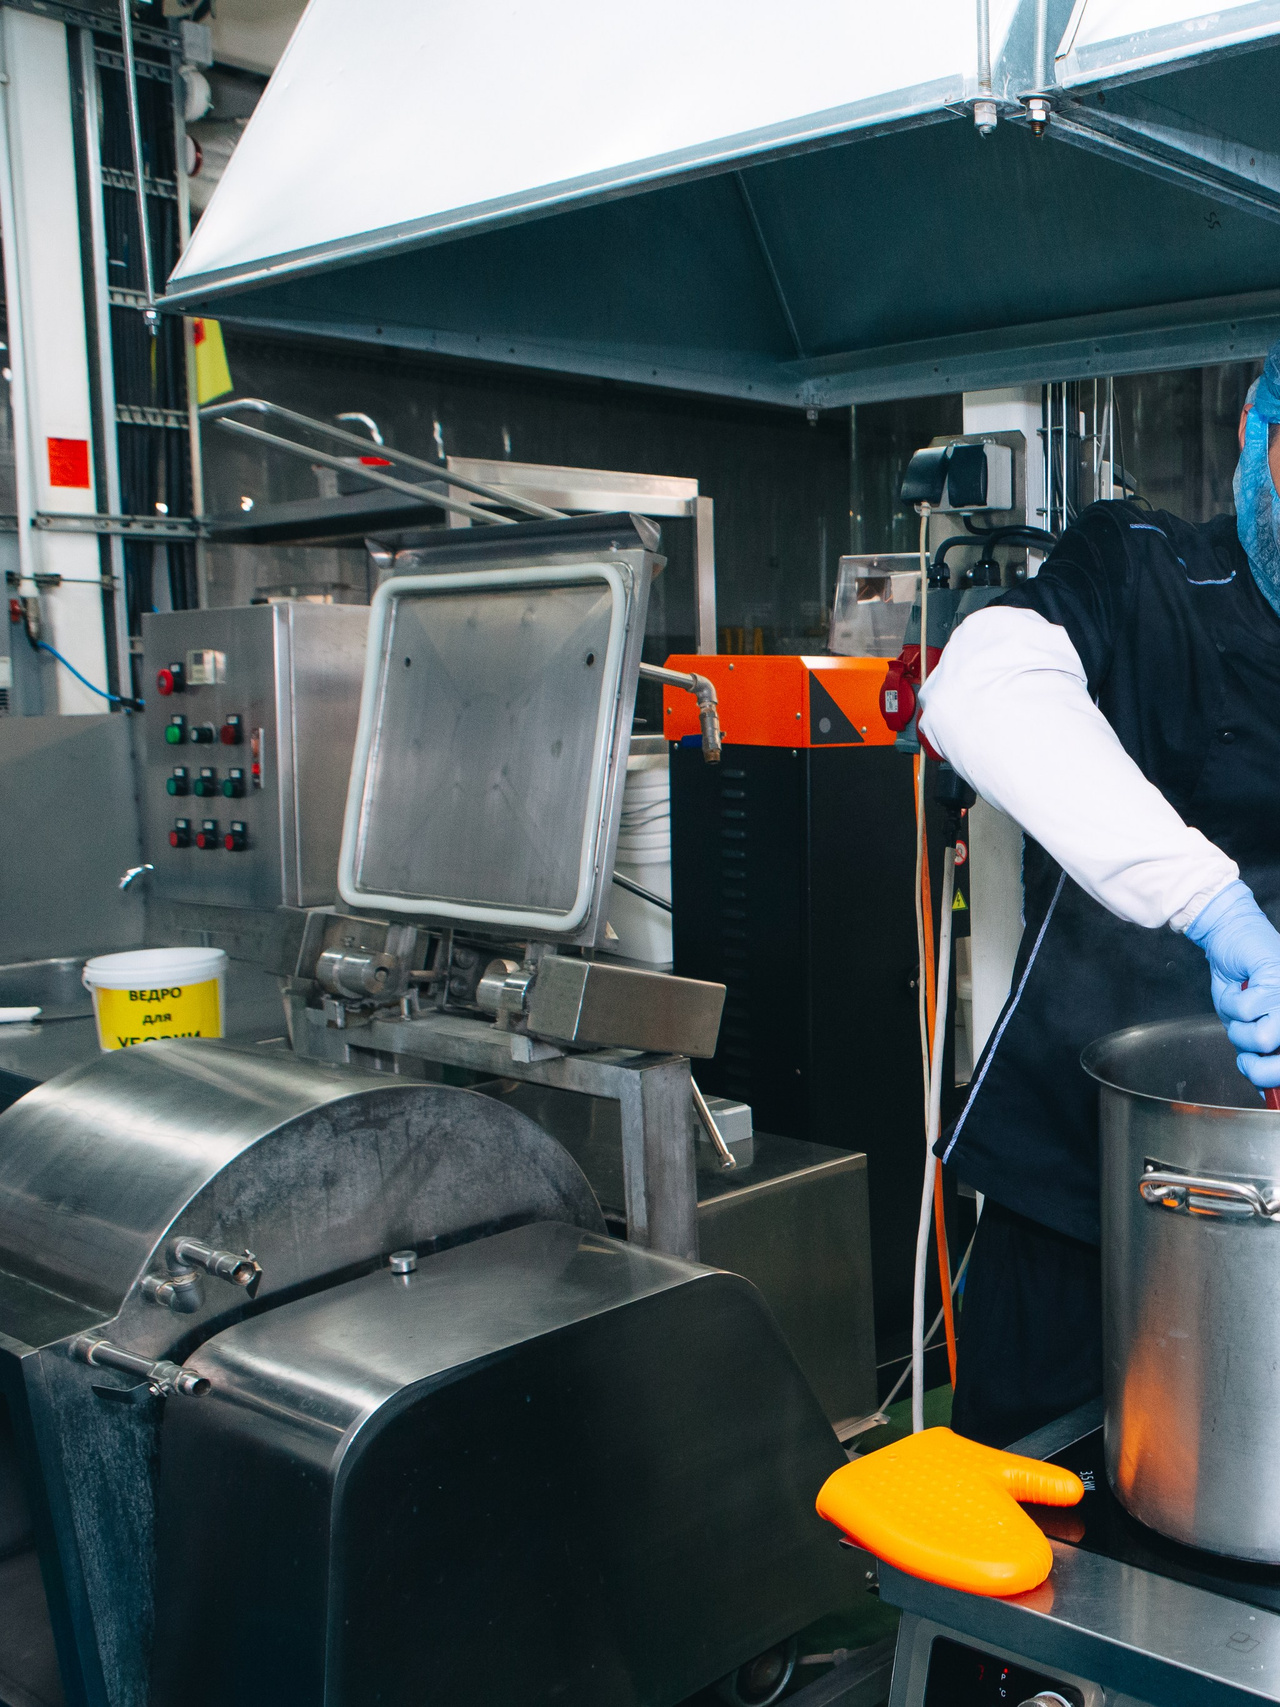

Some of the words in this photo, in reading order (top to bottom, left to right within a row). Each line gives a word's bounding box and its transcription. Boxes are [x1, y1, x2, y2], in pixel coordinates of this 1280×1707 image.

[128, 987, 182, 1003] ВЕДРО
[142, 1013, 173, 1026] для
[1001, 1673, 1007, 1681] P
